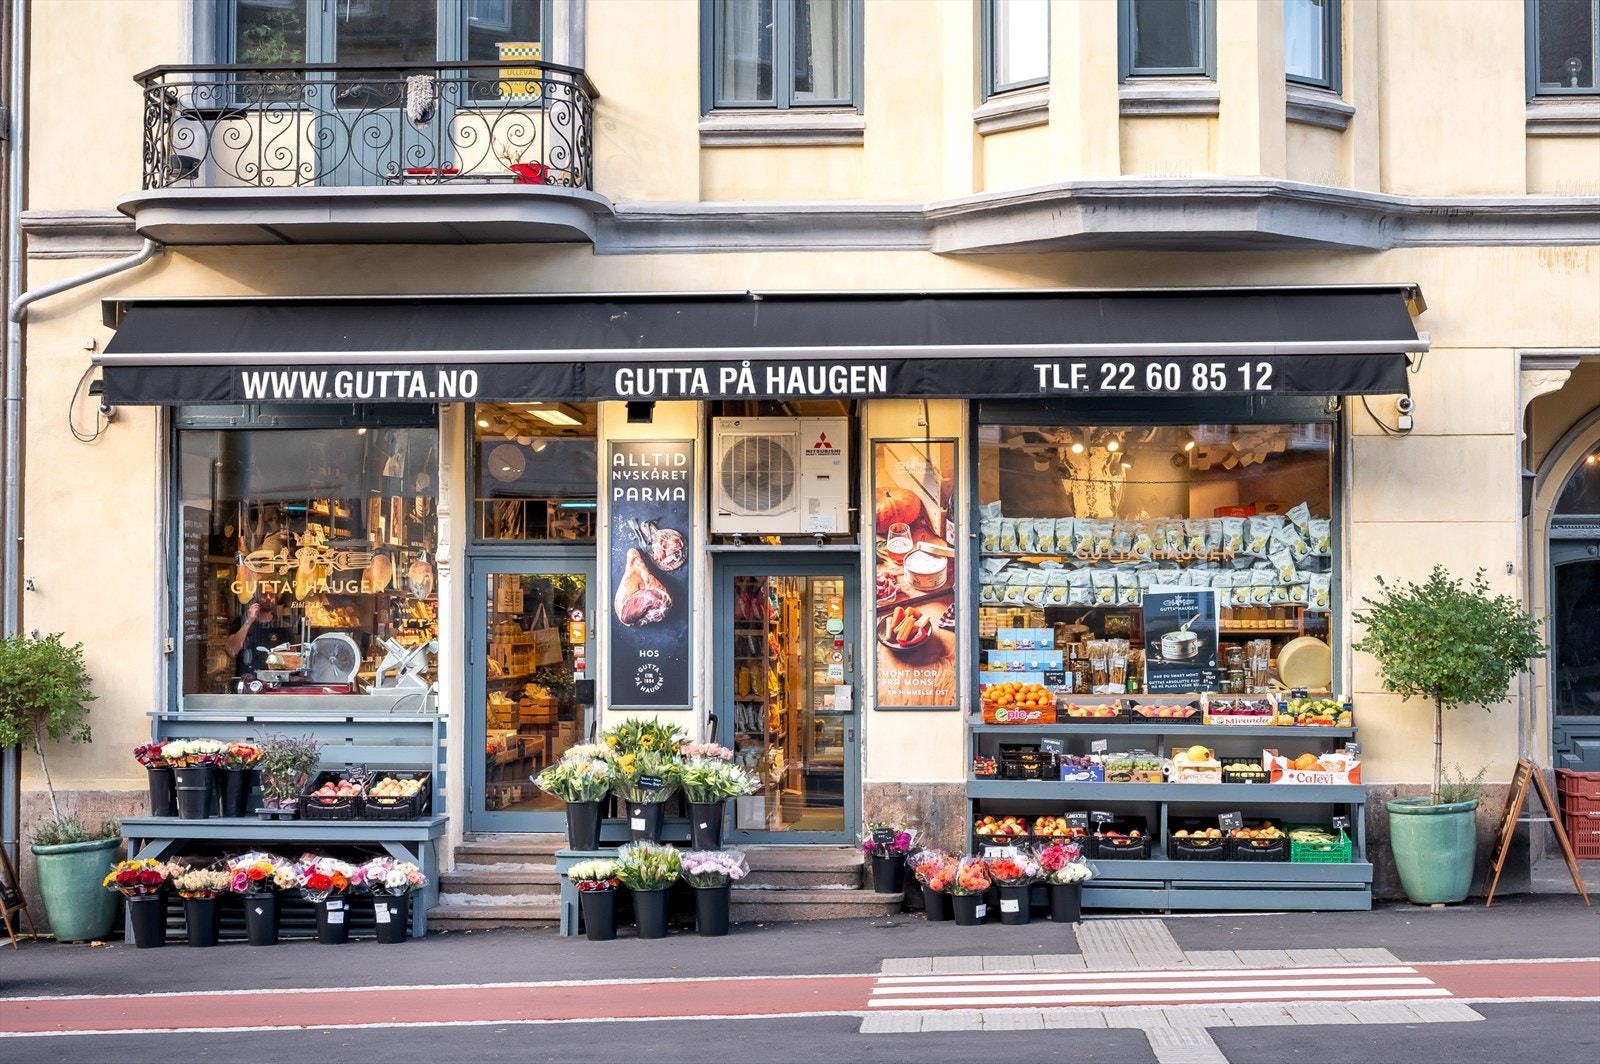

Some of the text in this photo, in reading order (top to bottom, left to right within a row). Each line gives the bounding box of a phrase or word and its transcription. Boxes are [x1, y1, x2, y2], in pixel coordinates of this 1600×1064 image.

[614, 360, 887, 396] GUTTA PÅ HAUGEN
[1033, 361, 1273, 391] TLF. 22 60 85 12
[241, 369, 478, 399] WWW.GUTTA.NO
[613, 453, 686, 467] ALLTID
[612, 467, 688, 480] NYSKÅRET
[613, 487, 686, 501] PARMA
[1075, 546, 1140, 560] GUTTA
[1152, 546, 1235, 561] HAUGEN
[230, 580, 293, 594] GUTTA
[305, 580, 385, 594] HAUGEN
[639, 649, 660, 657] HOS
[637, 663, 660, 673] GUTTA
[881, 669, 938, 677] MONT D'OR
[639, 676, 664, 693] HAUGEN
[882, 678, 932, 686] FRA MONS
[995, 707, 1027, 722] epic
[1225, 716, 1270, 725] Miranda
[1296, 772, 1334, 784] Calevi
